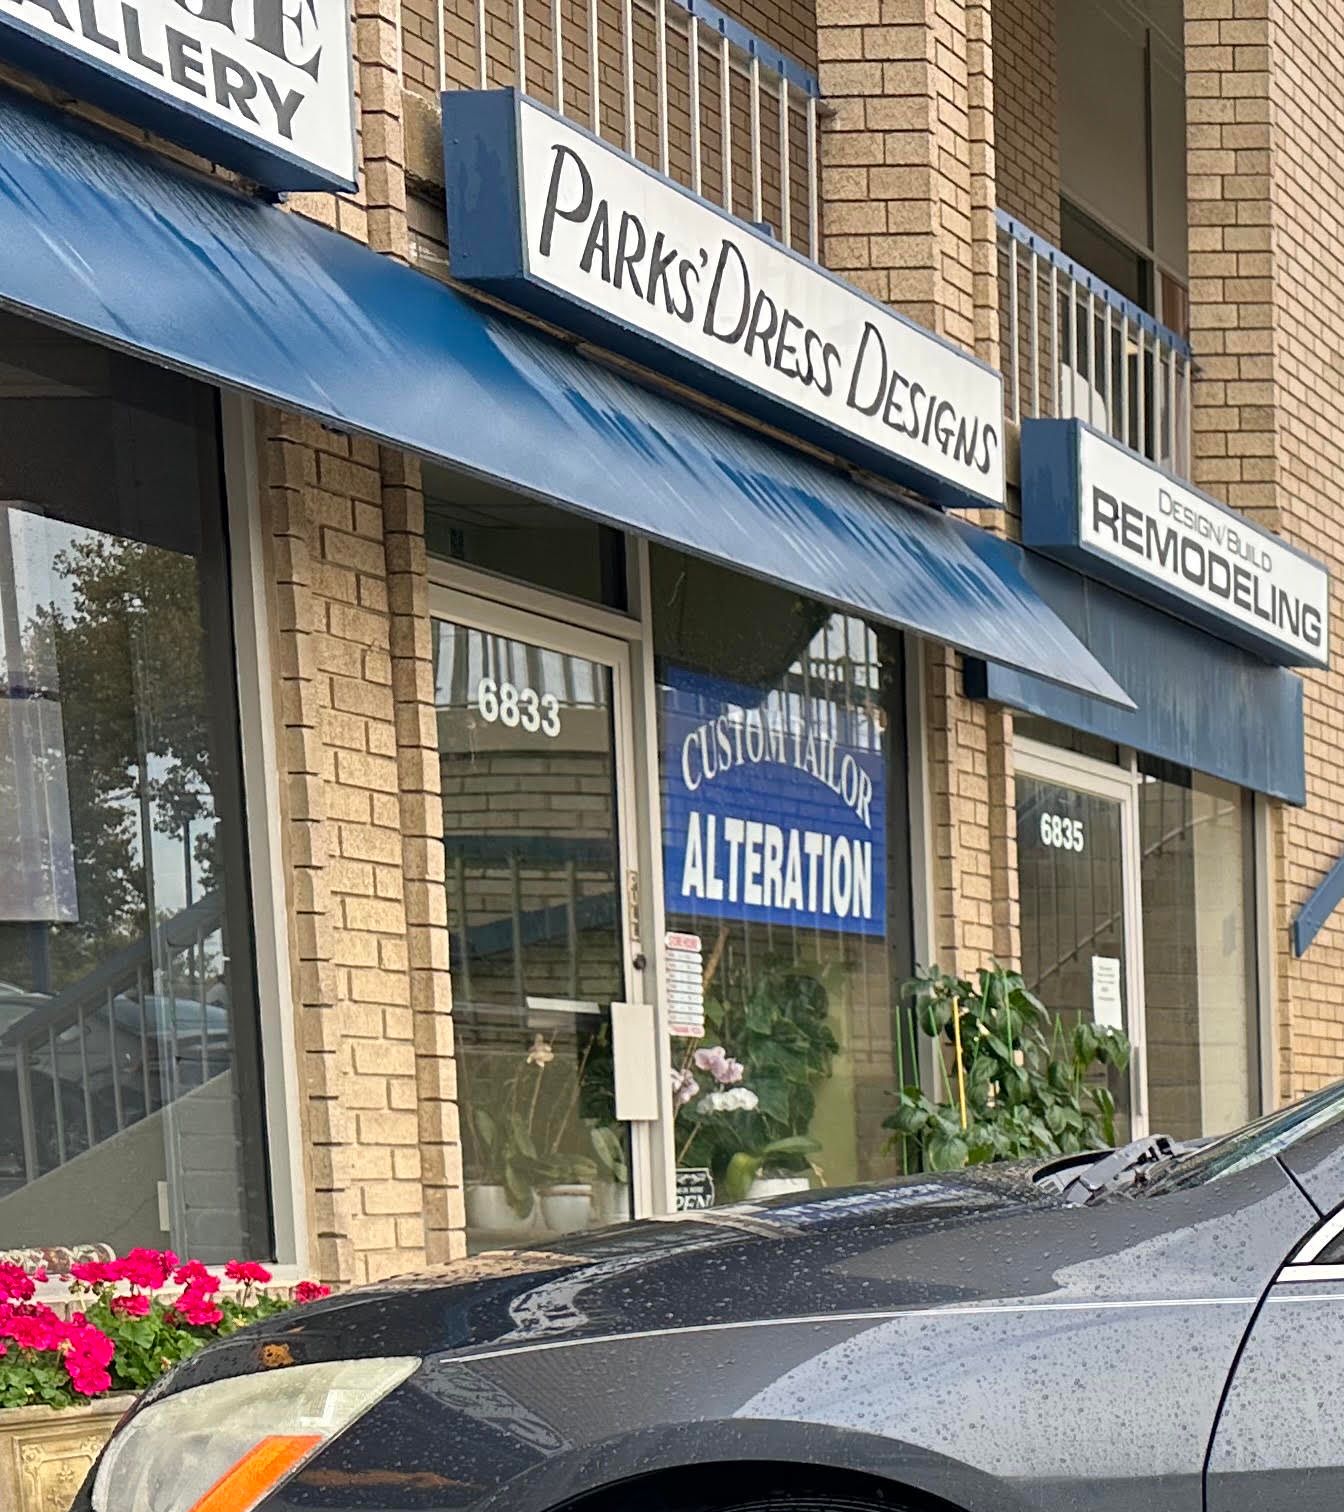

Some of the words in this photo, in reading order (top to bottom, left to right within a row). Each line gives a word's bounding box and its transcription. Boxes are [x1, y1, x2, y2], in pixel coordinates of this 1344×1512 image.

[538, 143, 708, 324] PARKS'
[702, 238, 840, 398] DRESS
[850, 321, 997, 475] DESIGNS
[1091, 484, 1322, 646] REMODELING
[478, 676, 561, 738] 6833
[681, 713, 786, 791] CUSTOM
[787, 722, 872, 830] TAILOR
[681, 811, 872, 919] ALTERATION
[1040, 812, 1084, 852] 6835
